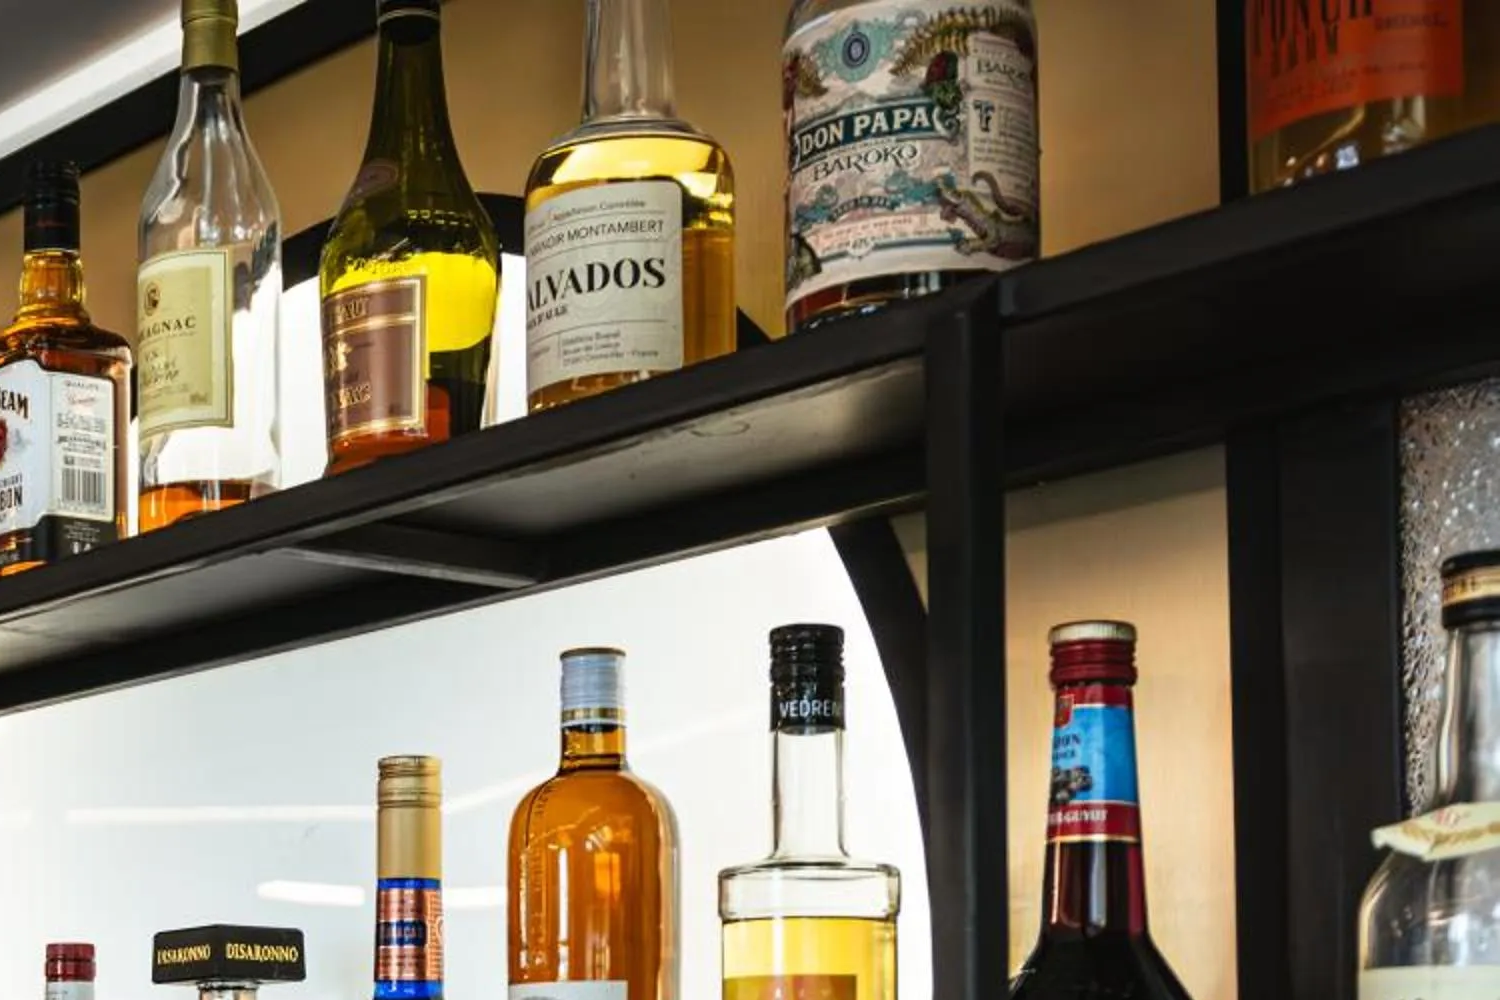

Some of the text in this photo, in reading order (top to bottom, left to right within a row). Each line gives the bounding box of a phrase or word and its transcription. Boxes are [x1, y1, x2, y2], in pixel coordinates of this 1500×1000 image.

[802, 106, 931, 155] DON PAPA
[813, 143, 918, 181] BAROKO
[567, 219, 665, 241] MONTAMBERT
[225, 942, 300, 964] DISARONNO
